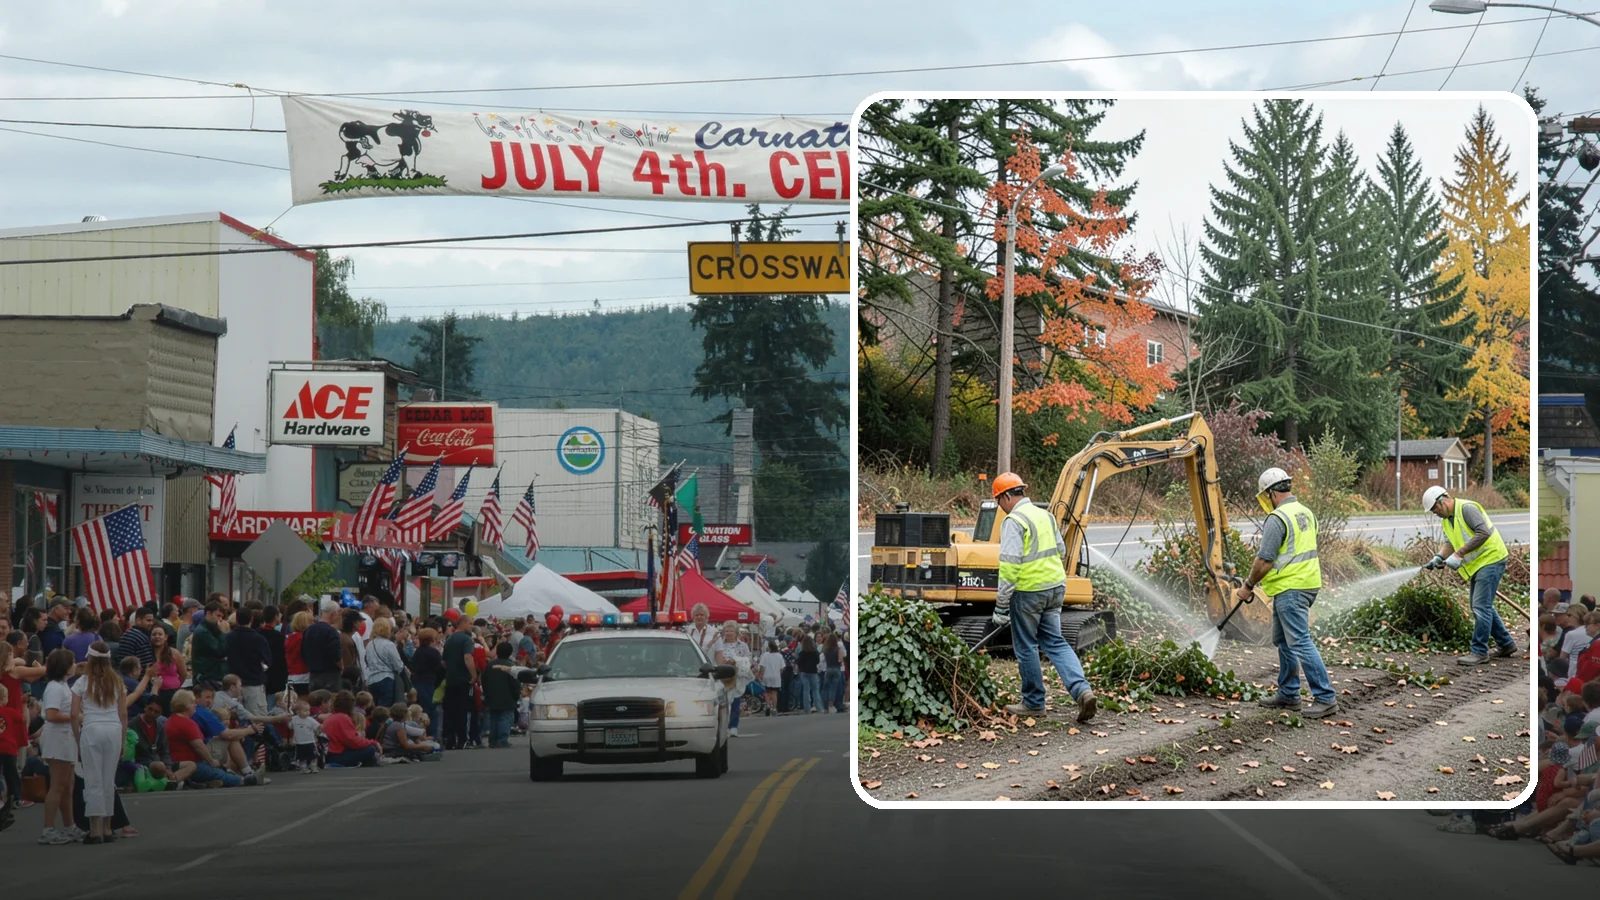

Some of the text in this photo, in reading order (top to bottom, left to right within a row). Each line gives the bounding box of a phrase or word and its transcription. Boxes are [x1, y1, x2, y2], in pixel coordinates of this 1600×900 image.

[481, 140, 604, 192] JULY
[632, 150, 746, 197] 4th.
[697, 254, 849, 279] CROSSWA
[283, 380, 373, 420] ACE
[406, 409, 452, 421] CEDAR
[284, 421, 370, 436] Hardware
[416, 428, 477, 447] Coca-Cola
[353, 467, 386, 479] Simpl
[96, 485, 124, 495] Vincent
[126, 486, 136, 495] de
[138, 486, 155, 495] Paul
[688, 526, 741, 535] CRNATION
[699, 535, 730, 543] GLASS
